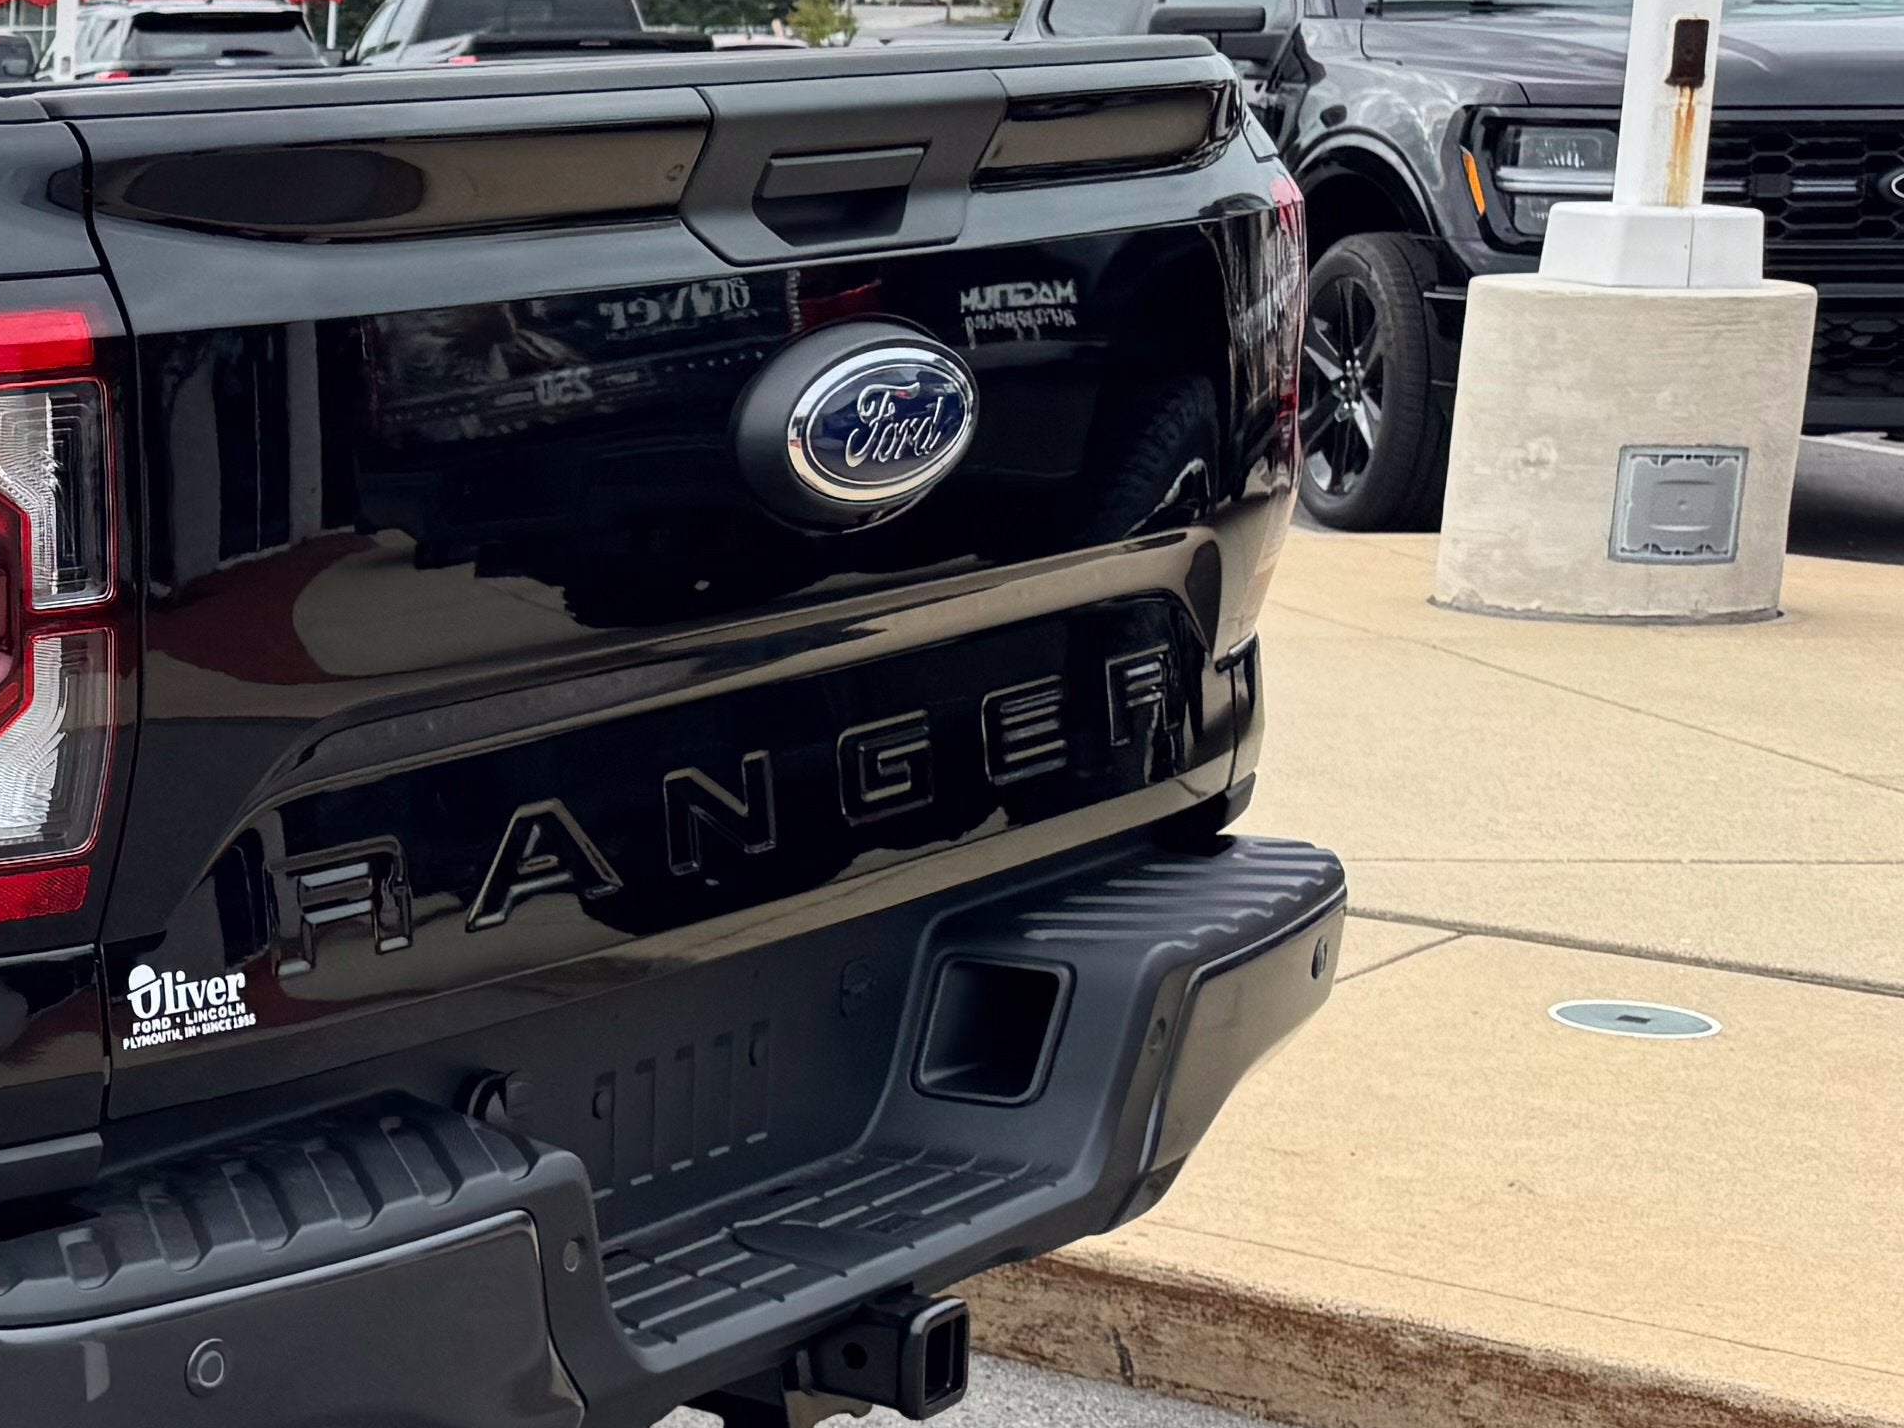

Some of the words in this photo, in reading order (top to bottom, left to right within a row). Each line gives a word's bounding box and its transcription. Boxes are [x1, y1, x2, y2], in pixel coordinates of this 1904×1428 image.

[845, 381, 944, 468] Ford
[268, 643, 1182, 976] RANGER
[127, 964, 246, 1019] Oliver
[132, 1017, 171, 1035] FORD
[184, 1002, 246, 1025] LINCOLN
